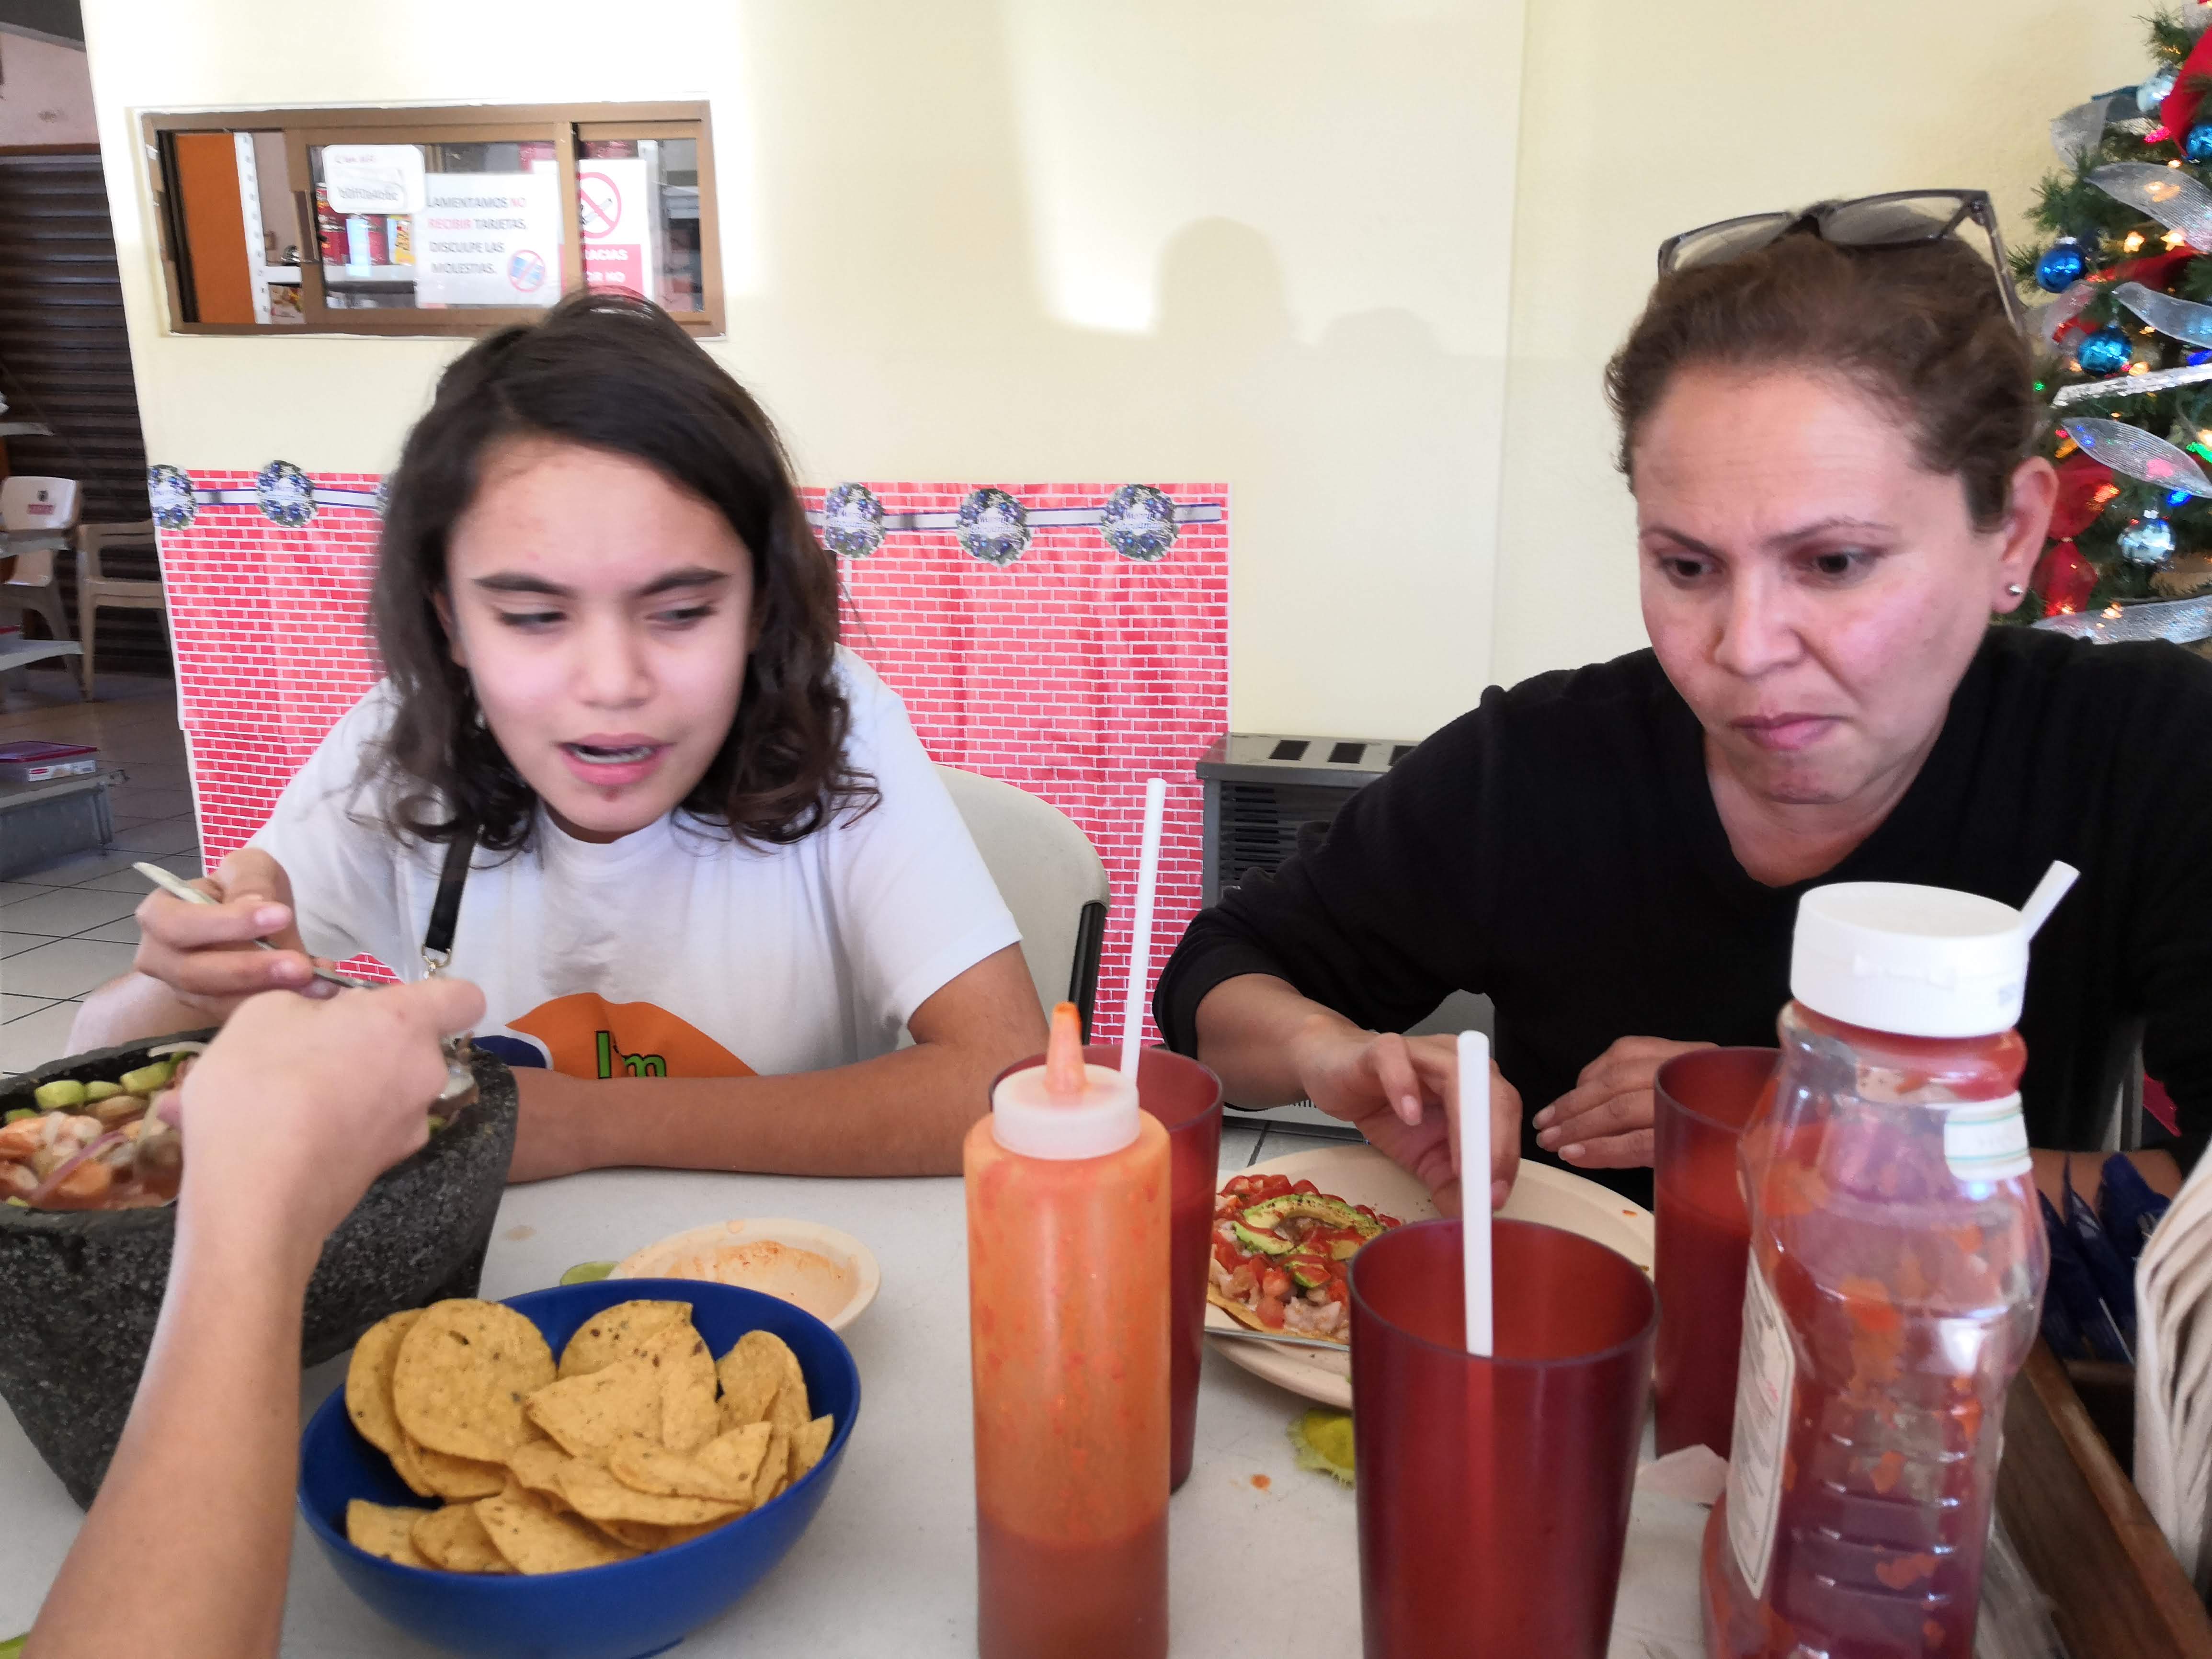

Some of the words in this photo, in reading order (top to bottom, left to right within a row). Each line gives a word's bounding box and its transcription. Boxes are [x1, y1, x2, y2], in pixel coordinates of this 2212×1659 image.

[426, 197, 508, 208] LAMENTAMOS
[510, 197, 526, 207] NO
[428, 218, 471, 229] RECIBIR
[429, 241, 483, 253] DISCULPE
[484, 241, 505, 253] LAS
[605, 271, 626, 283] NO
